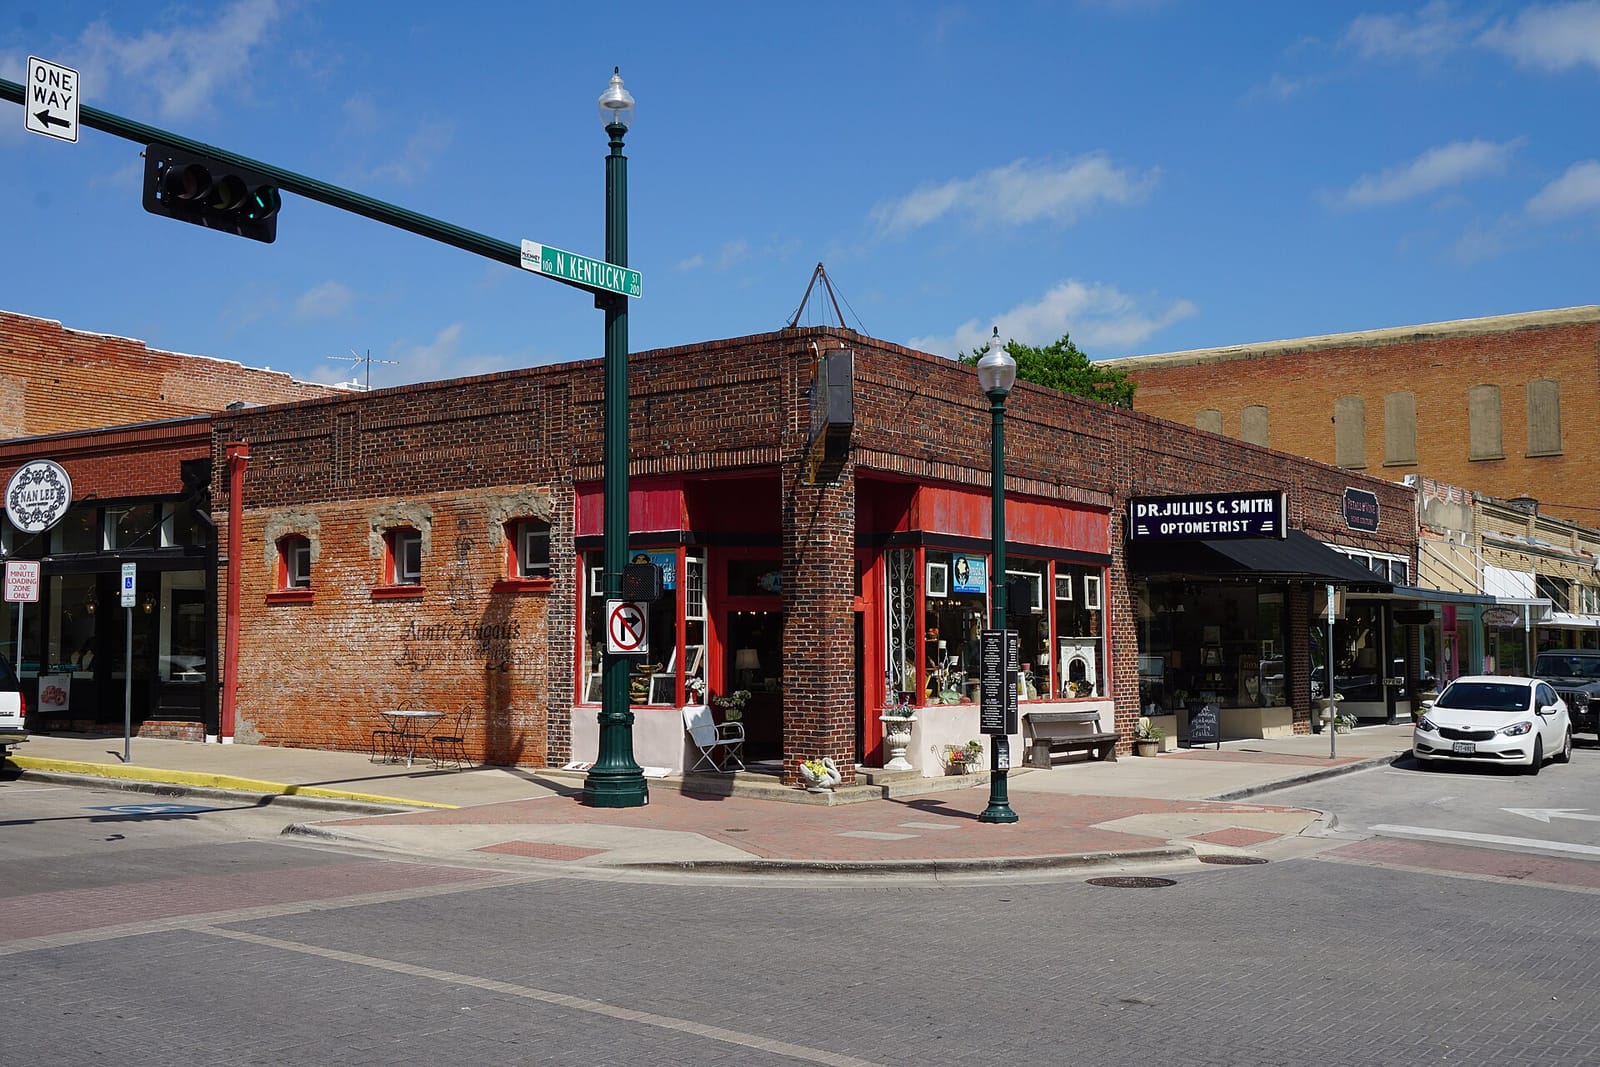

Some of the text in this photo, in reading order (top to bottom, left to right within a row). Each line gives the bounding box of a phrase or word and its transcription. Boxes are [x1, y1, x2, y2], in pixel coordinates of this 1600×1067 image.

[35, 66, 72, 91] ONE
[33, 85, 72, 110] WAY
[542, 252, 638, 291] 100 N KENTUCKY ST
[630, 284, 640, 295] 200
[40, 488, 55, 501] LEE
[1231, 499, 1273, 514] SMITH
[1160, 520, 1249, 534] OPTOMETRIST
